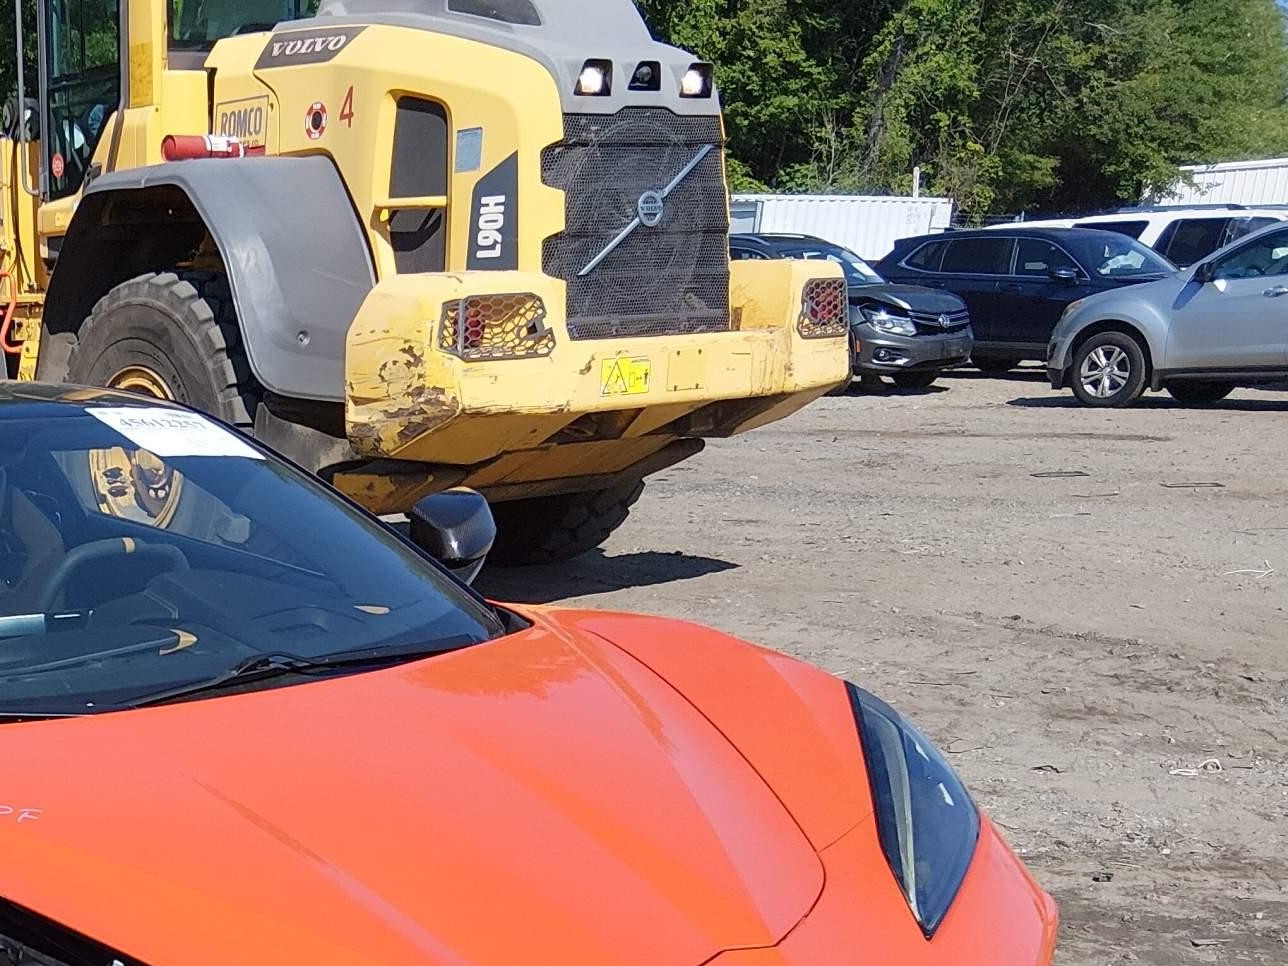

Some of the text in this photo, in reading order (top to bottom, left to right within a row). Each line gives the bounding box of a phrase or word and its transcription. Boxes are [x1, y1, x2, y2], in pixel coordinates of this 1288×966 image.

[271, 35, 347, 57] VOLVO
[220, 106, 263, 138] ROMCO
[339, 85, 355, 129] 4
[475, 194, 506, 259] L90H
